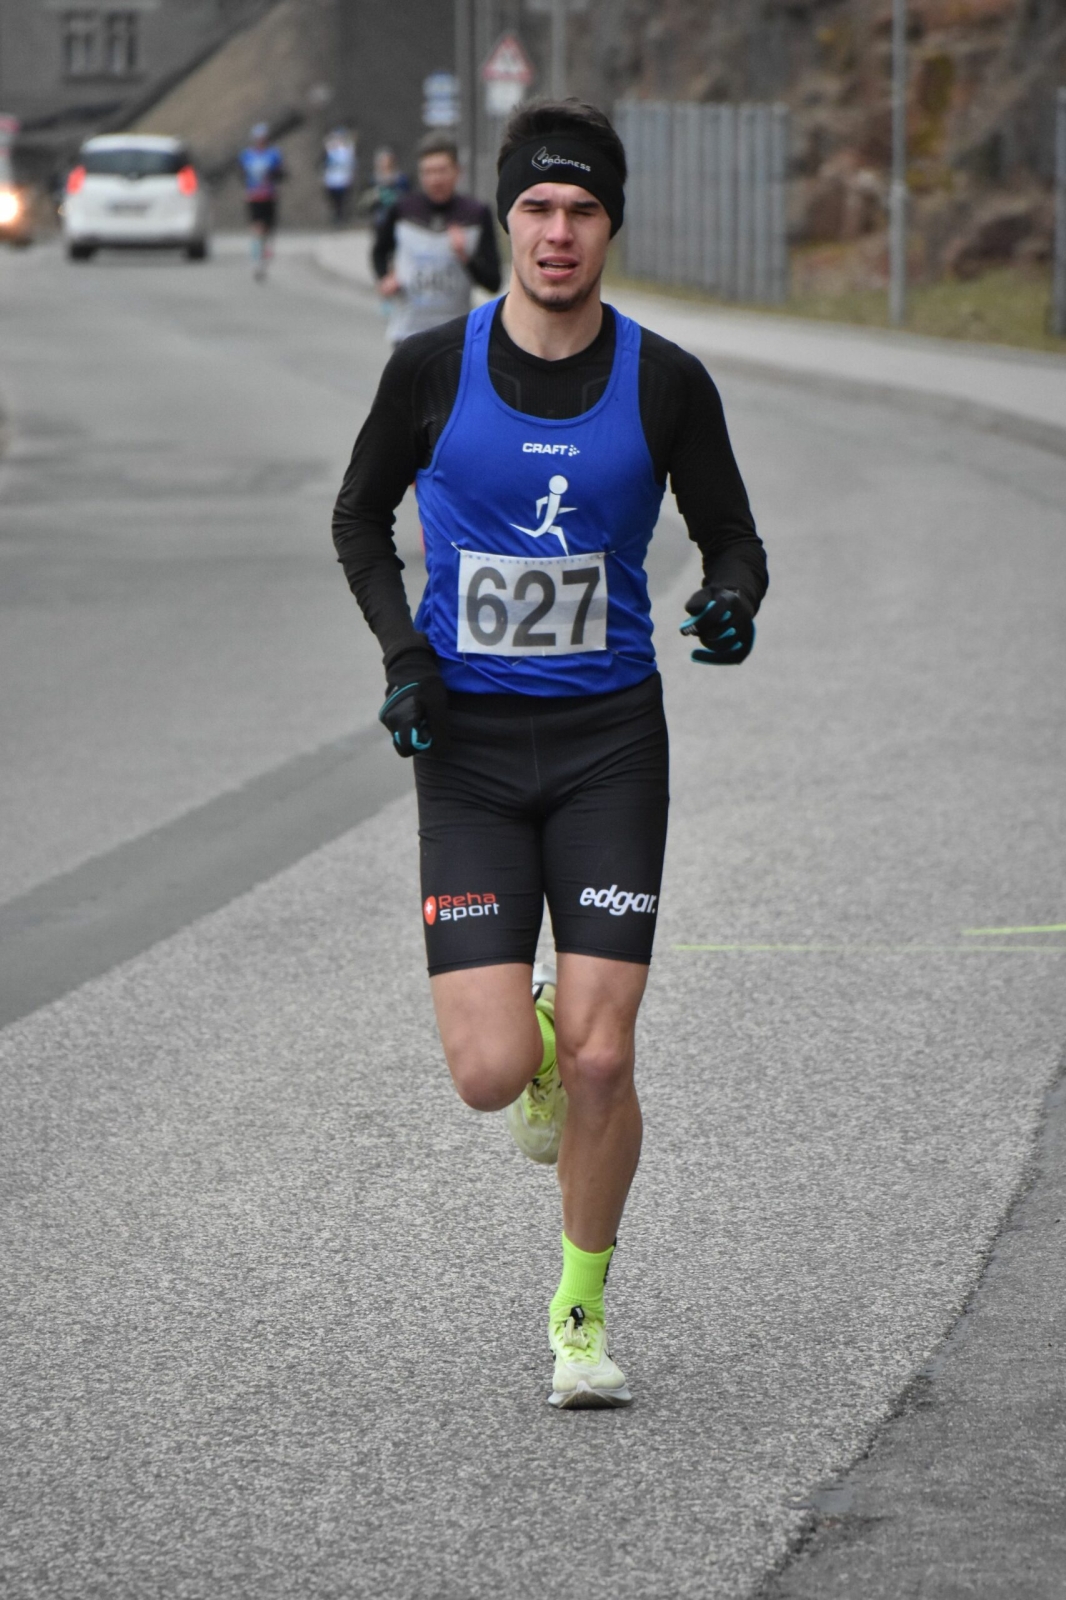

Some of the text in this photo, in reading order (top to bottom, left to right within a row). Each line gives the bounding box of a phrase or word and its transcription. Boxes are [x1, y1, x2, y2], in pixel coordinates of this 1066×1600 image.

[541, 158, 591, 172] PROGRESS
[522, 442, 568, 455] CRAFT
[466, 566, 600, 647] 627
[438, 892, 496, 908] Reha
[439, 903, 500, 921] sport
